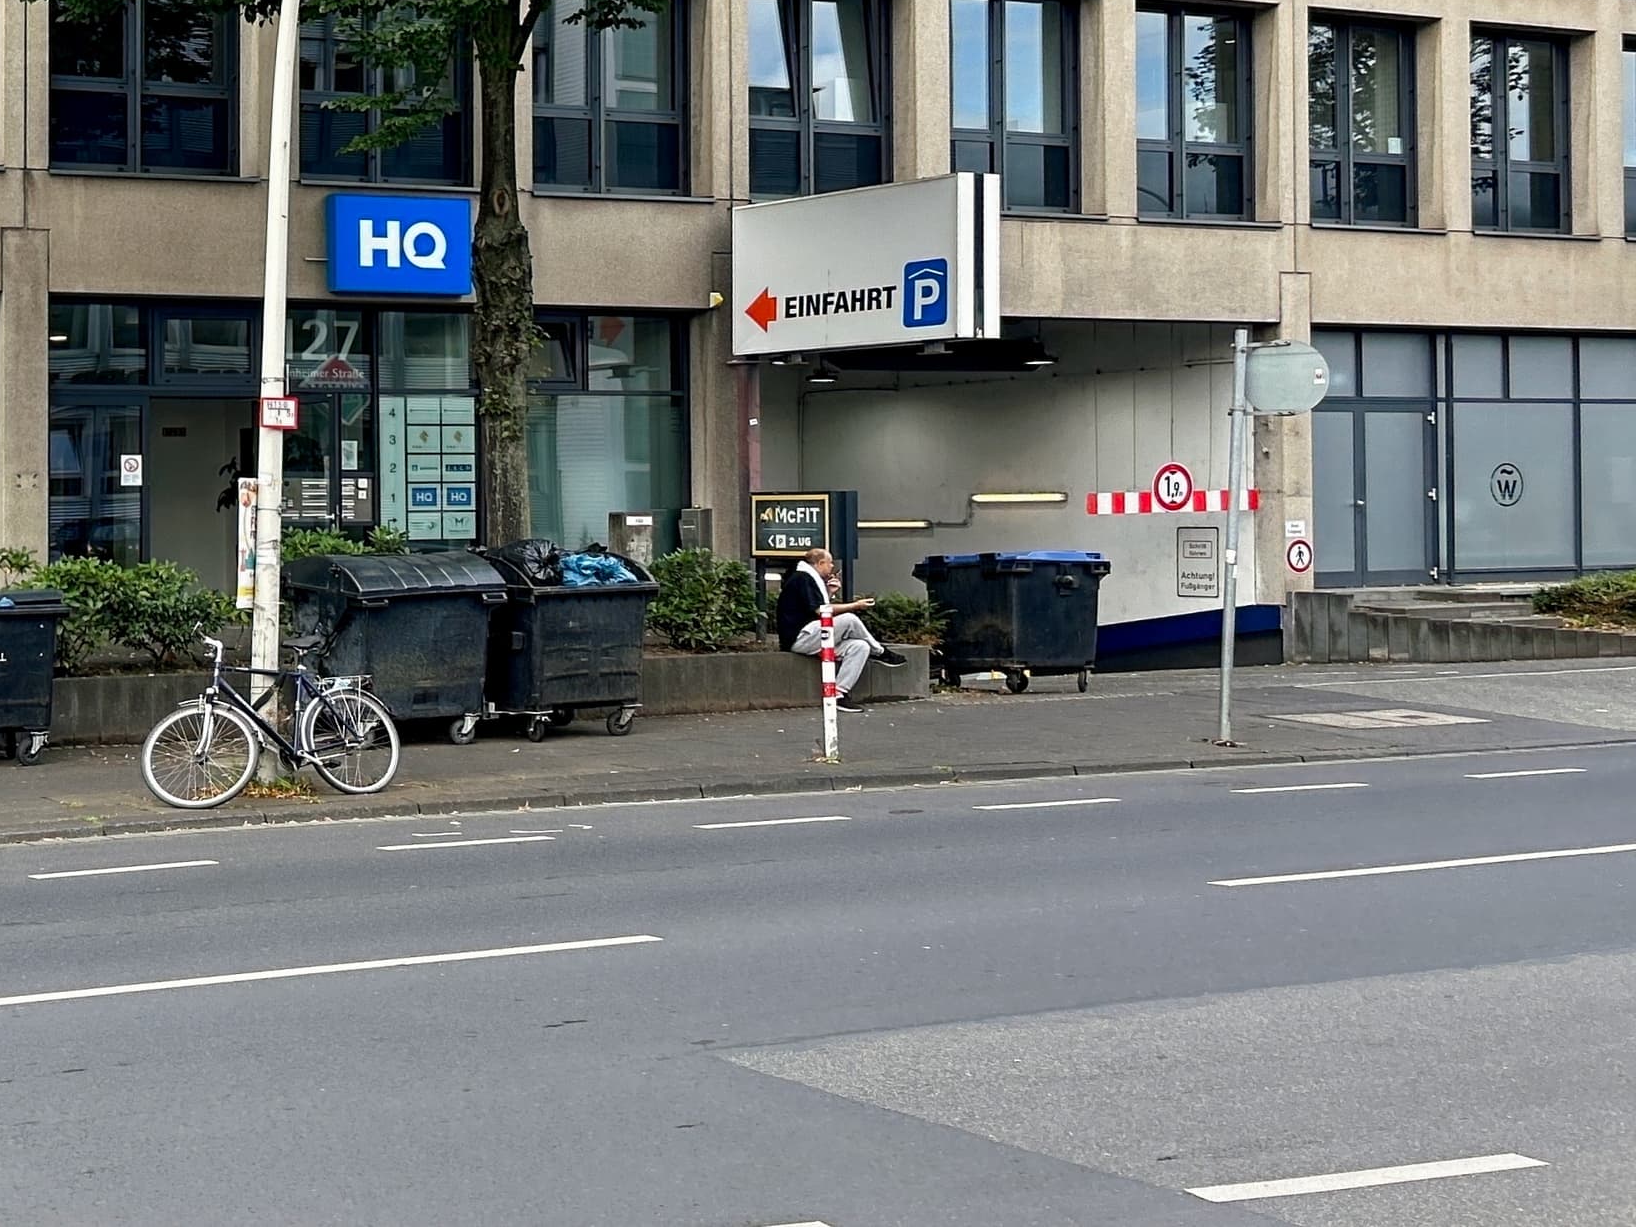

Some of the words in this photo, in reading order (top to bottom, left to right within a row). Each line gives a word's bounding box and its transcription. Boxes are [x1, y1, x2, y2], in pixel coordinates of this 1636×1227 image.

[359, 219, 447, 269] HQ
[784, 285, 897, 319] EINFAHRT
[914, 278, 940, 320] P
[286, 319, 359, 360] 127
[389, 408, 396, 418] 4
[389, 435, 396, 445] 3
[390, 463, 397, 473] 2
[391, 493, 396, 503] 1
[416, 493, 433, 501] HQ
[451, 493, 468, 501] HQ
[775, 506, 820, 524] McFIT
[1181, 571, 1215, 581] Achtung!
